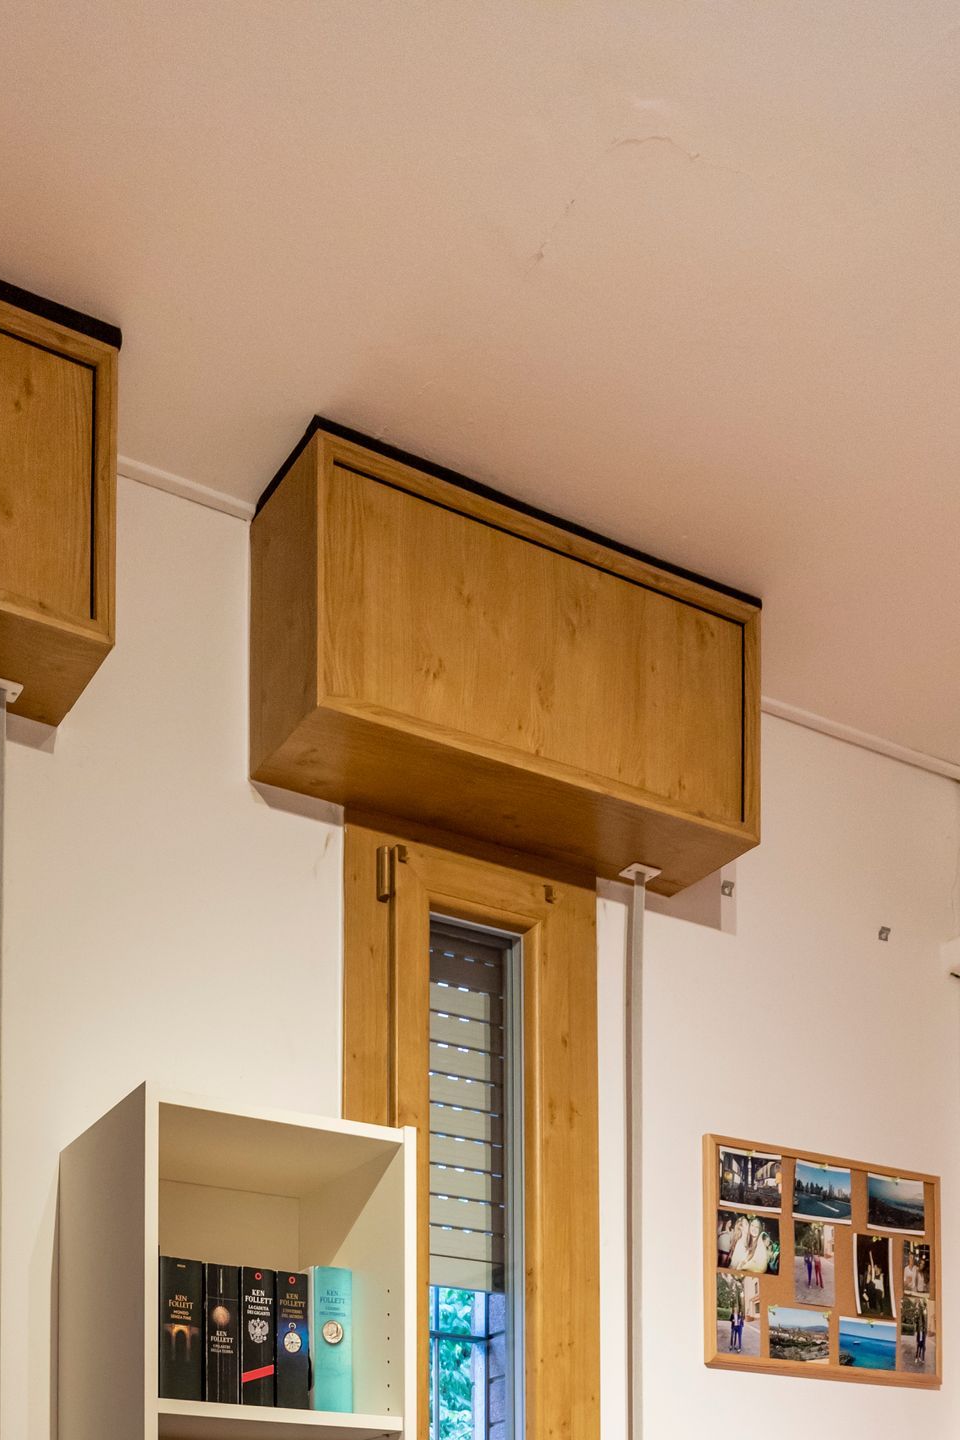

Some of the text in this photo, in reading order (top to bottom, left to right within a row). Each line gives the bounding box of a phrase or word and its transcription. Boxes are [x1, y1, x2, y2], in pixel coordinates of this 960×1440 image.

[175, 1294, 187, 1302] KEN
[245, 1295, 273, 1305] FOLLETT
[286, 1292, 298, 1300] KEN
[319, 1296, 345, 1304] FOLLETT
[168, 1299, 194, 1310] FOLLETT
[279, 1299, 306, 1308] FOLLETT
[210, 1335, 234, 1344] FOLLETT
